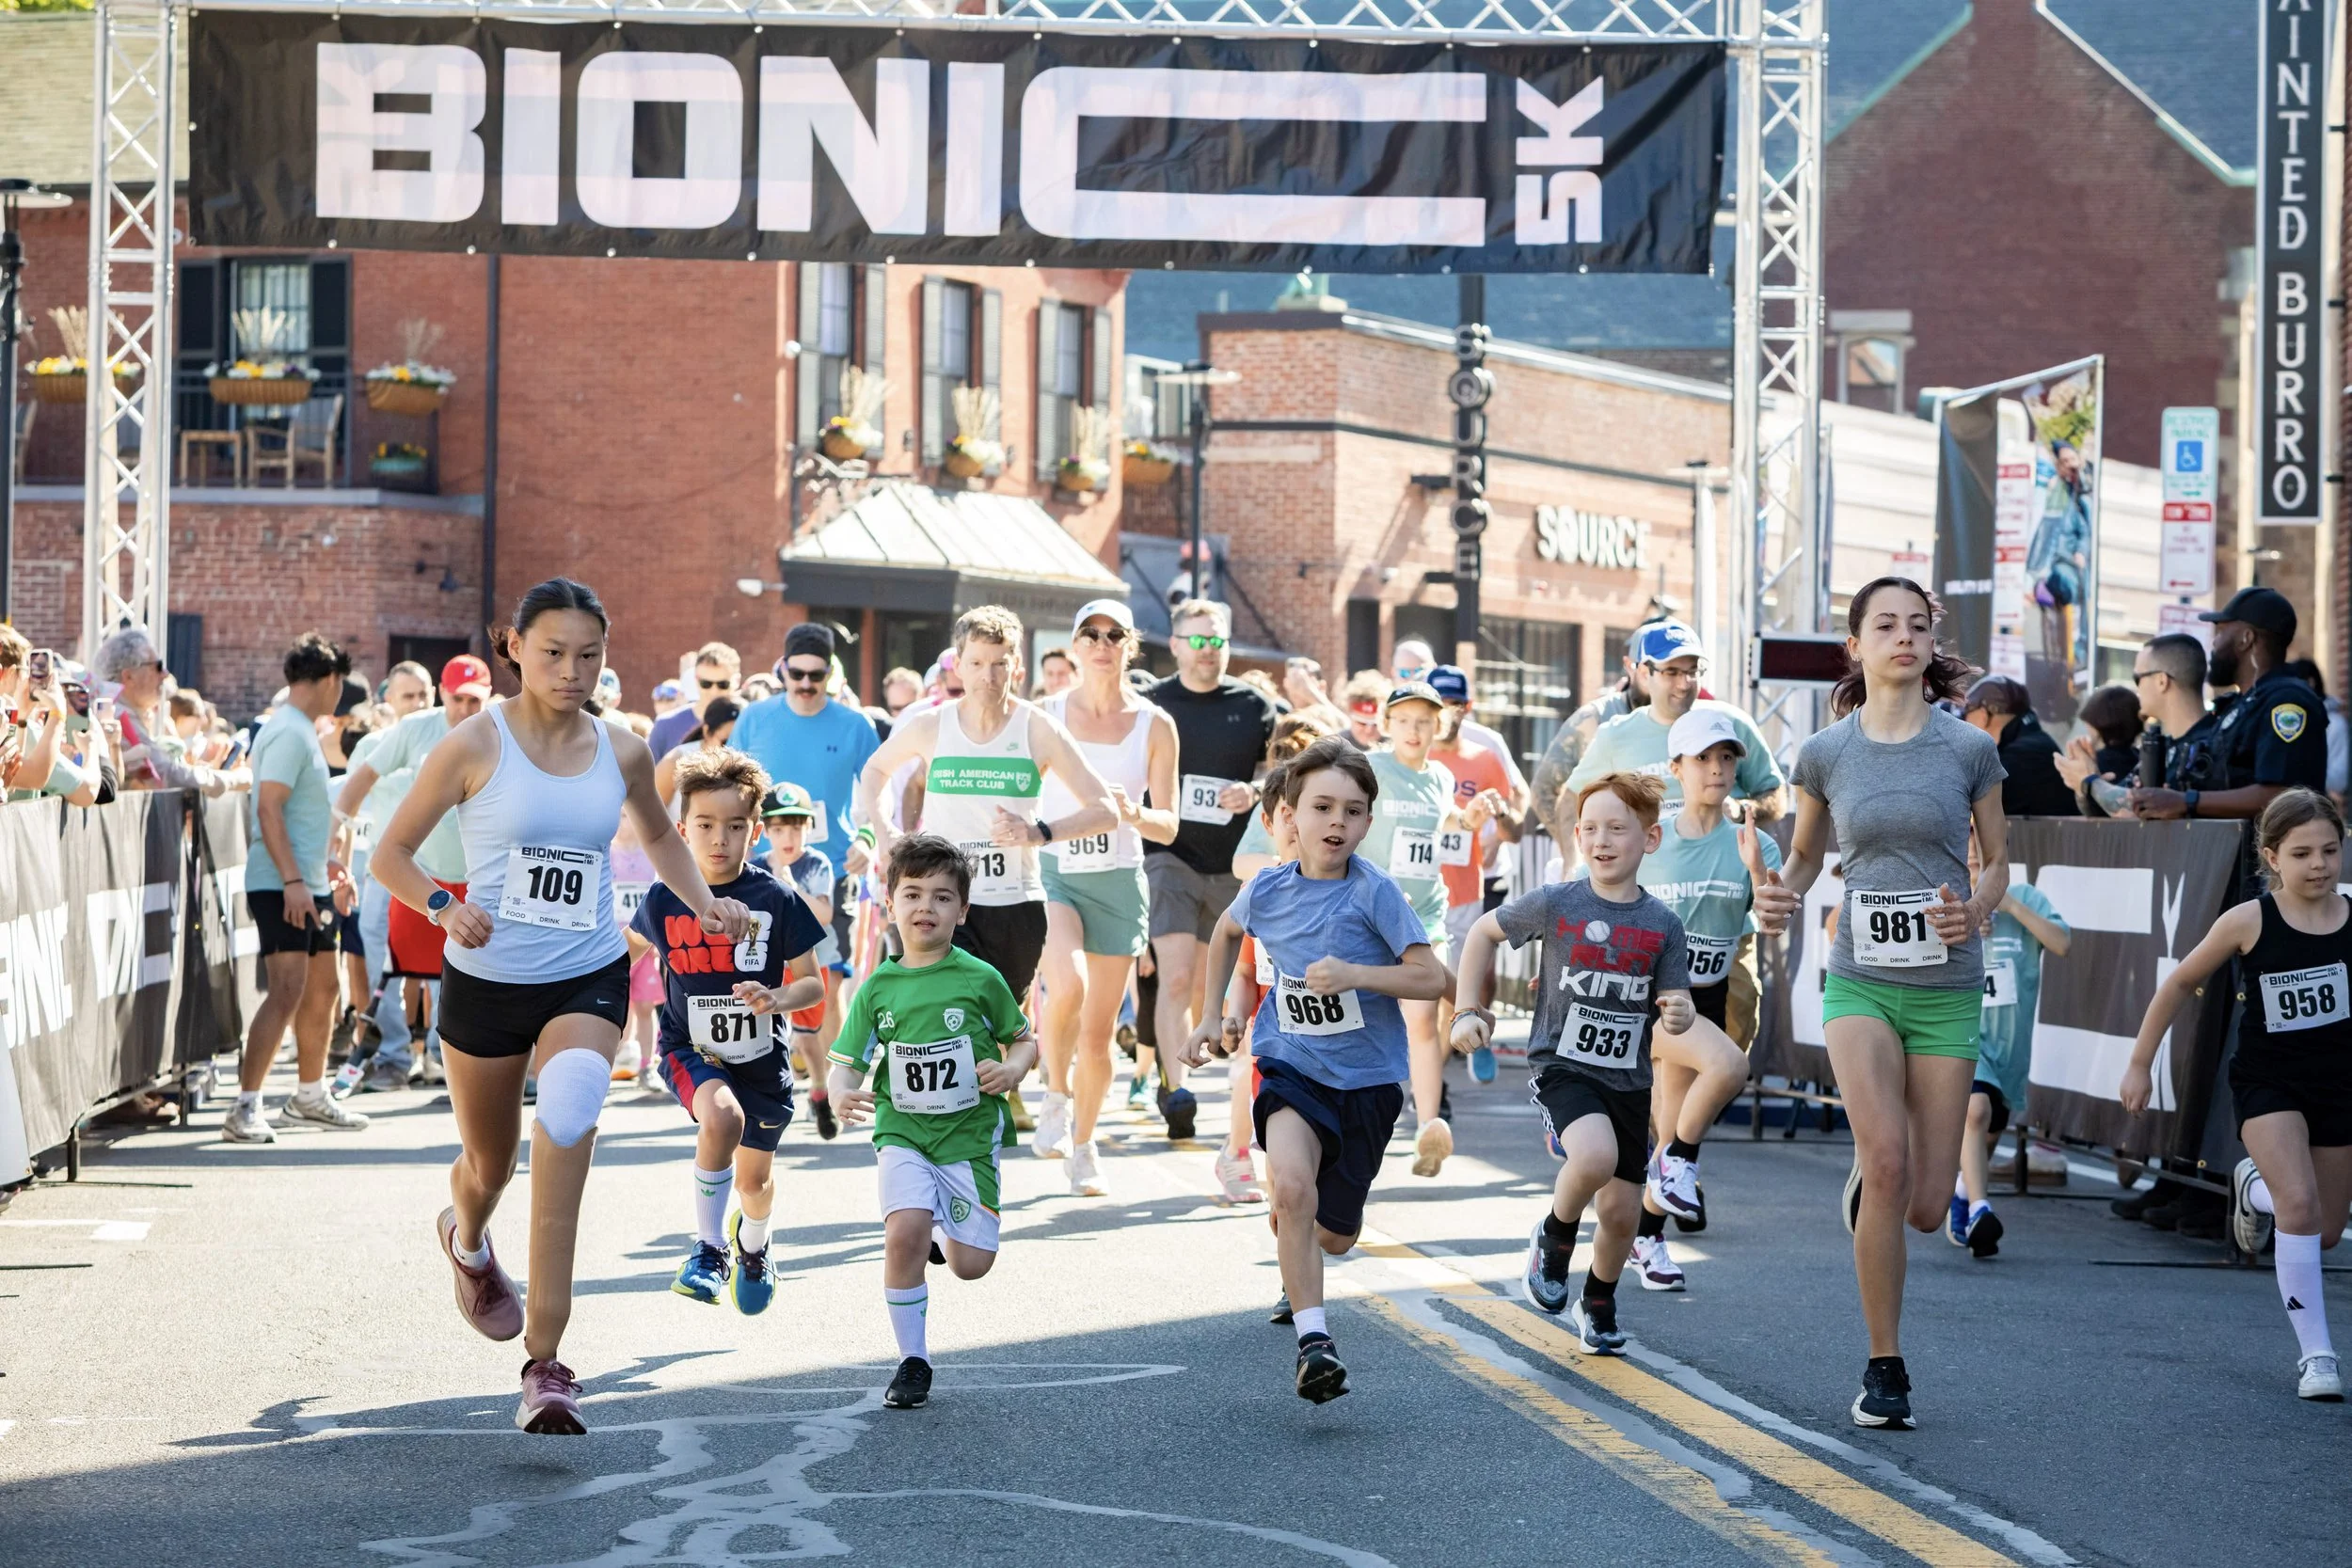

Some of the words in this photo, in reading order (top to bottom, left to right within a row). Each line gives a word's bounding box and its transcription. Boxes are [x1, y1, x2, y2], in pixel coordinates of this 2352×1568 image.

[2276, 0, 2312, 250] INTED
[316, 41, 1487, 247] BIONIC
[1515, 75, 1604, 245] 5K
[2272, 272, 2308, 510] BURRO
[1535, 503, 1653, 570] SOURCE
[940, 779, 973, 788] TRACK
[976, 781, 1005, 789] CLUB
[959, 769, 1015, 781] AMERICAN
[1193, 787, 1223, 808] 93
[1069, 832, 1108, 855] 969
[1408, 843, 1433, 864] 114
[521, 847, 585, 864] BIONIC
[970, 852, 1006, 878] 13
[527, 865, 583, 905] 109
[1860, 893, 1922, 905] BIONIC
[505, 910, 527, 920] FOOD
[539, 916, 561, 925] DRINK
[1869, 911, 1927, 943] 981
[1685, 935, 1731, 947] IONIC
[667, 945, 735, 975] ARE
[1569, 943, 1651, 976] RUN
[2269, 968, 2328, 986] BIONIC
[697, 997, 745, 1007] BIONIC
[1285, 993, 1345, 1025] 968
[2278, 983, 2336, 1020] 958
[877, 1010, 895, 1030] 26
[1578, 1006, 1634, 1025] BIONIC
[710, 1013, 757, 1044] 871
[895, 1041, 953, 1056] BIONIC
[1576, 1023, 1631, 1058] 933
[904, 1057, 960, 1092] 872
[957, 1097, 976, 1106] DRINK
